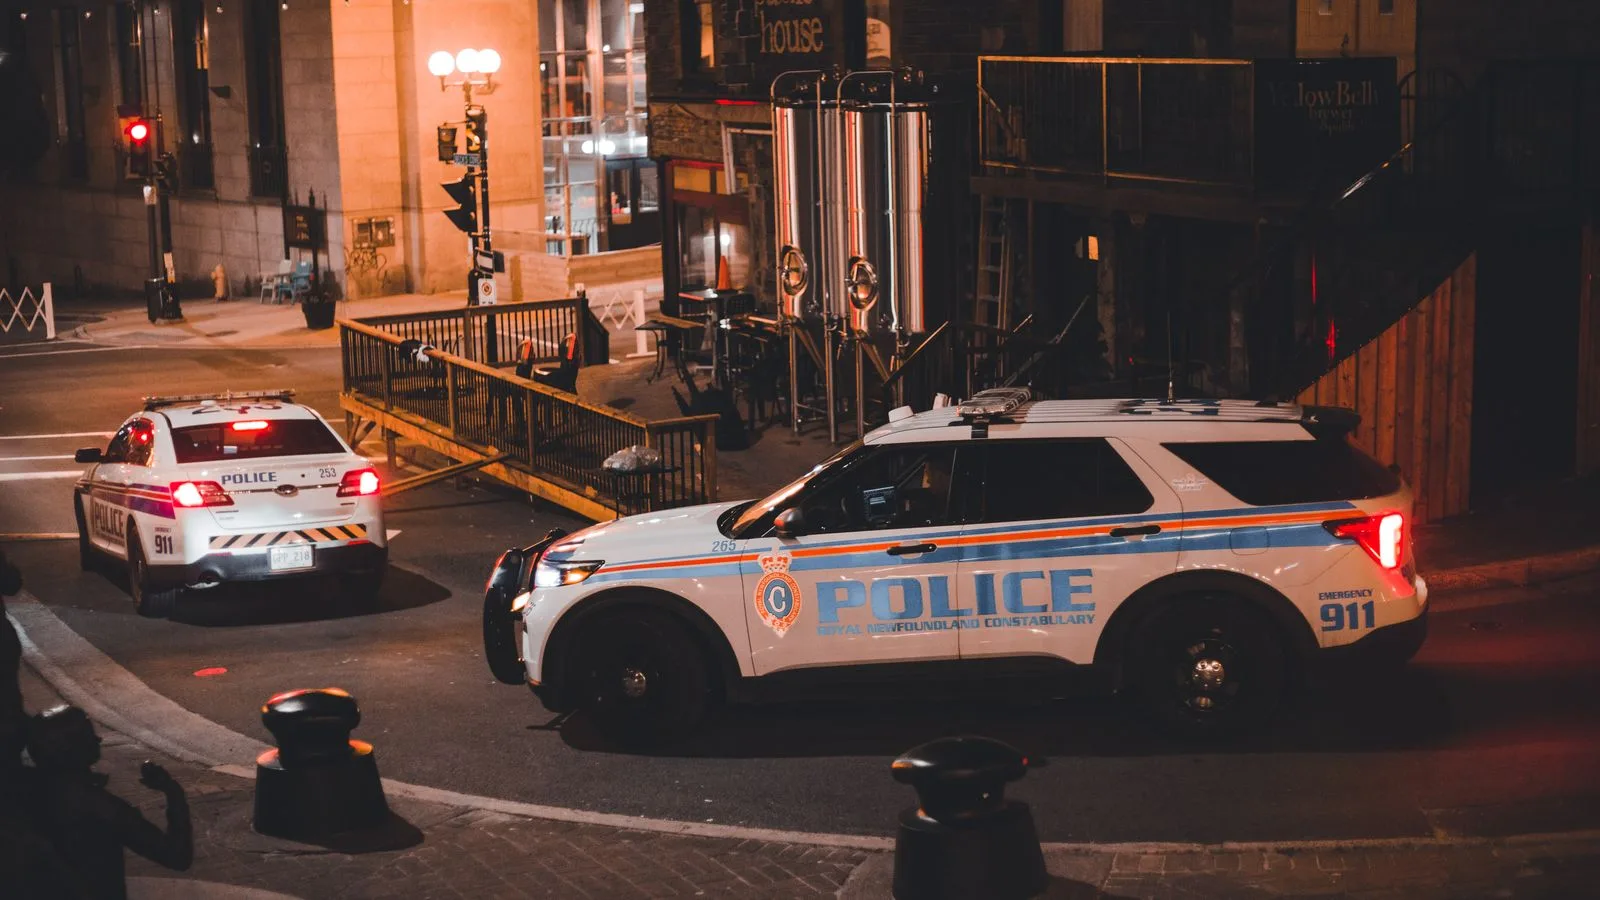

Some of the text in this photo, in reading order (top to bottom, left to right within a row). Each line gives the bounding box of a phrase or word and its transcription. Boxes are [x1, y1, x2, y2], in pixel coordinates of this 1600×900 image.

[759, 10, 824, 53] house
[1267, 80, 1380, 107] YelowBell
[221, 470, 278, 485] POLICE
[319, 467, 337, 479] 253
[94, 502, 124, 537] POLICE
[154, 534, 173, 555] 911
[711, 540, 737, 553] 265
[768, 587, 785, 612] C
[816, 568, 1096, 624] POLICE
[1318, 588, 1373, 601] EMERGENCY
[816, 613, 1096, 636] ROYAL NEWFOUNDLAND CONSTABULARY
[1320, 600, 1375, 632] 911
